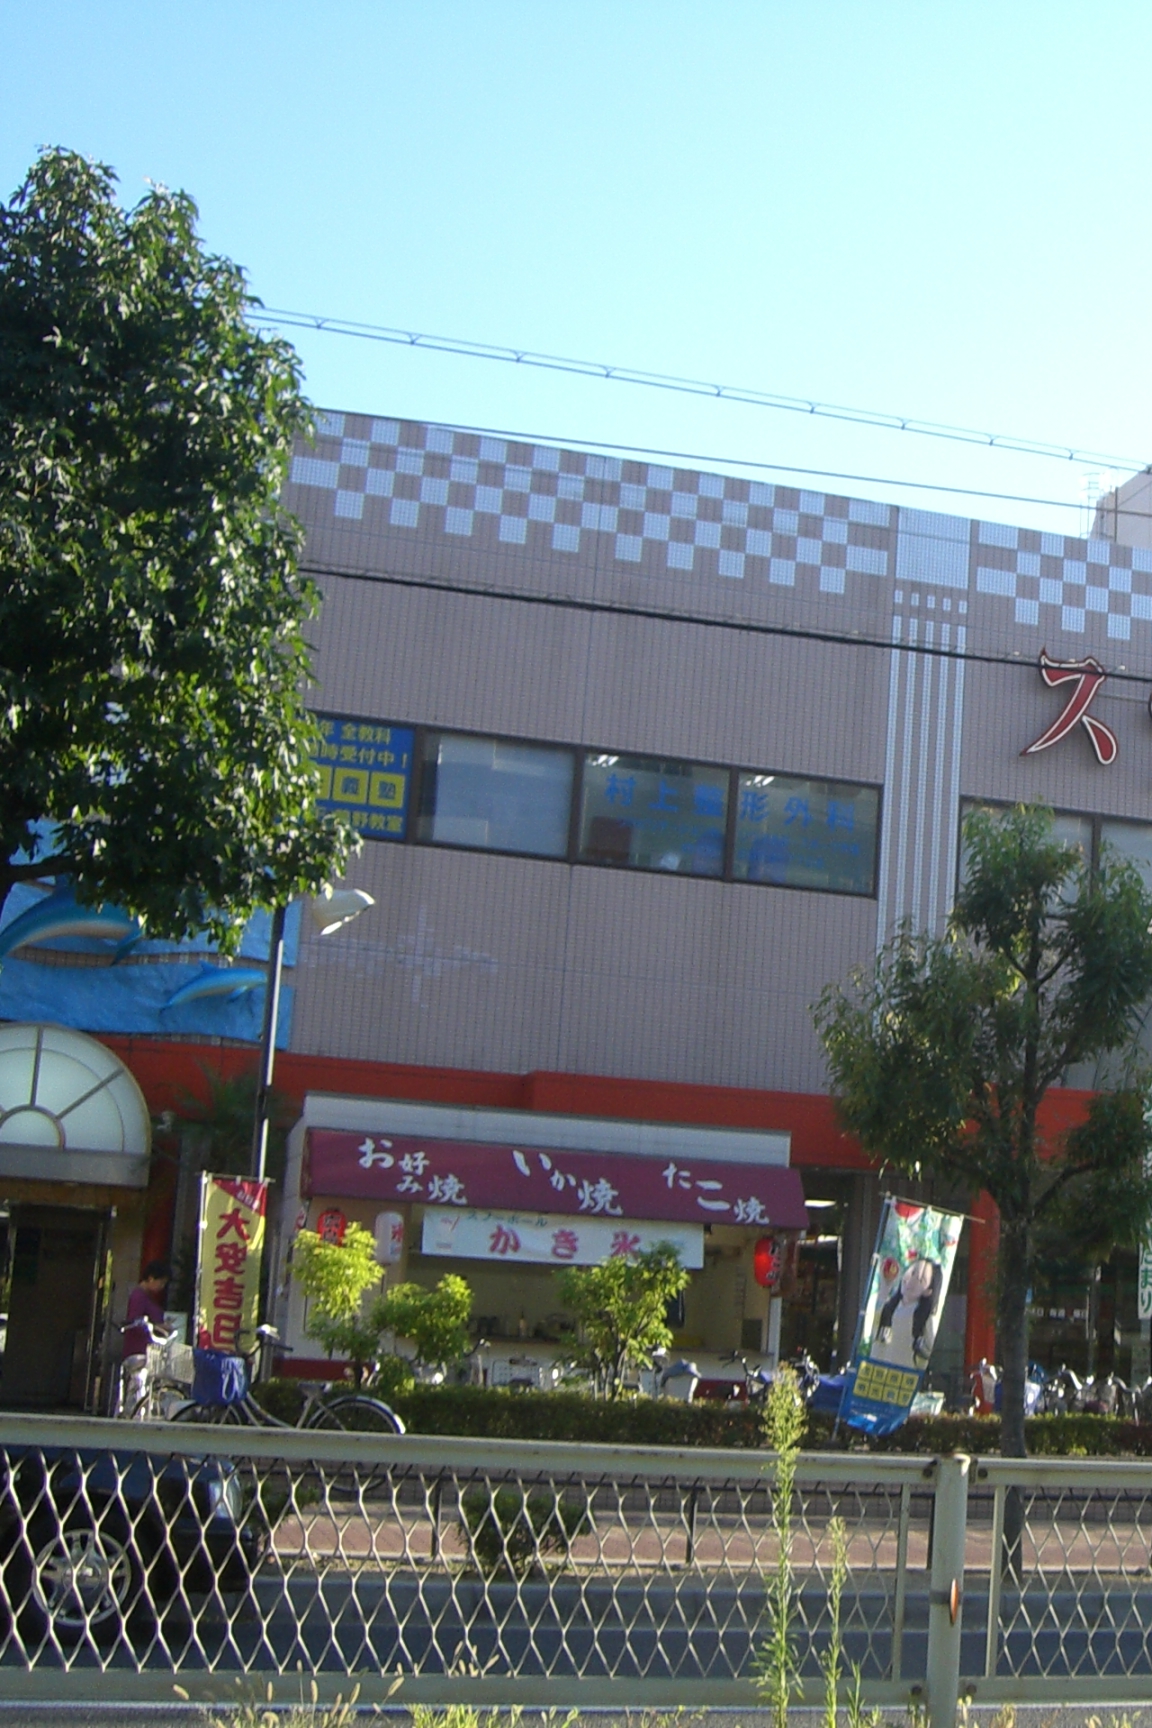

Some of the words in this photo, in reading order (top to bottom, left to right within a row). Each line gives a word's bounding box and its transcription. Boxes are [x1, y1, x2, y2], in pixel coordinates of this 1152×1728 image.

[357, 1136, 468, 1206] お好み焼
[511, 1149, 624, 1216] いか焼
[661, 1161, 770, 1225] たこ焼
[212, 1206, 251, 1346] 大安吉日
[488, 1223, 643, 1261] かき氷
